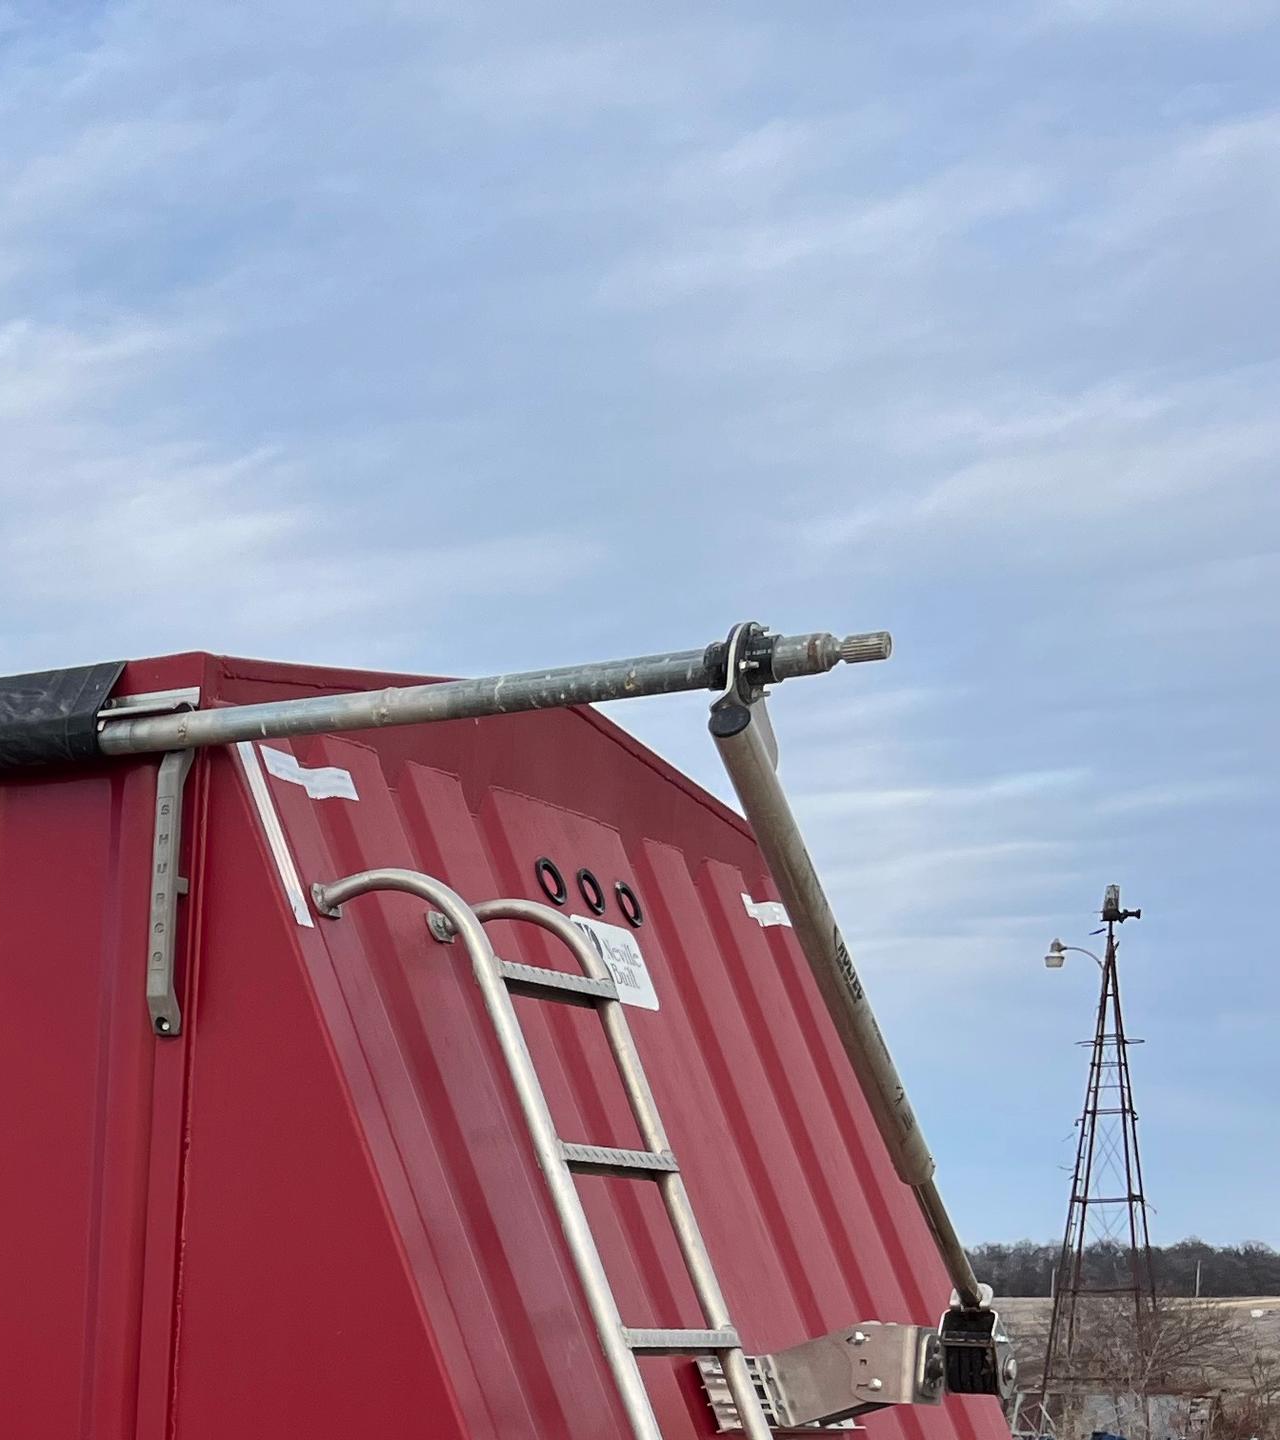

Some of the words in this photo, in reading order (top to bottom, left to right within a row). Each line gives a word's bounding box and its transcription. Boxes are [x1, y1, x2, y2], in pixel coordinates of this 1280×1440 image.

[151, 803, 171, 962] SHURCO
[601, 937, 642, 968] Neville
[608, 962, 641, 990] Built
